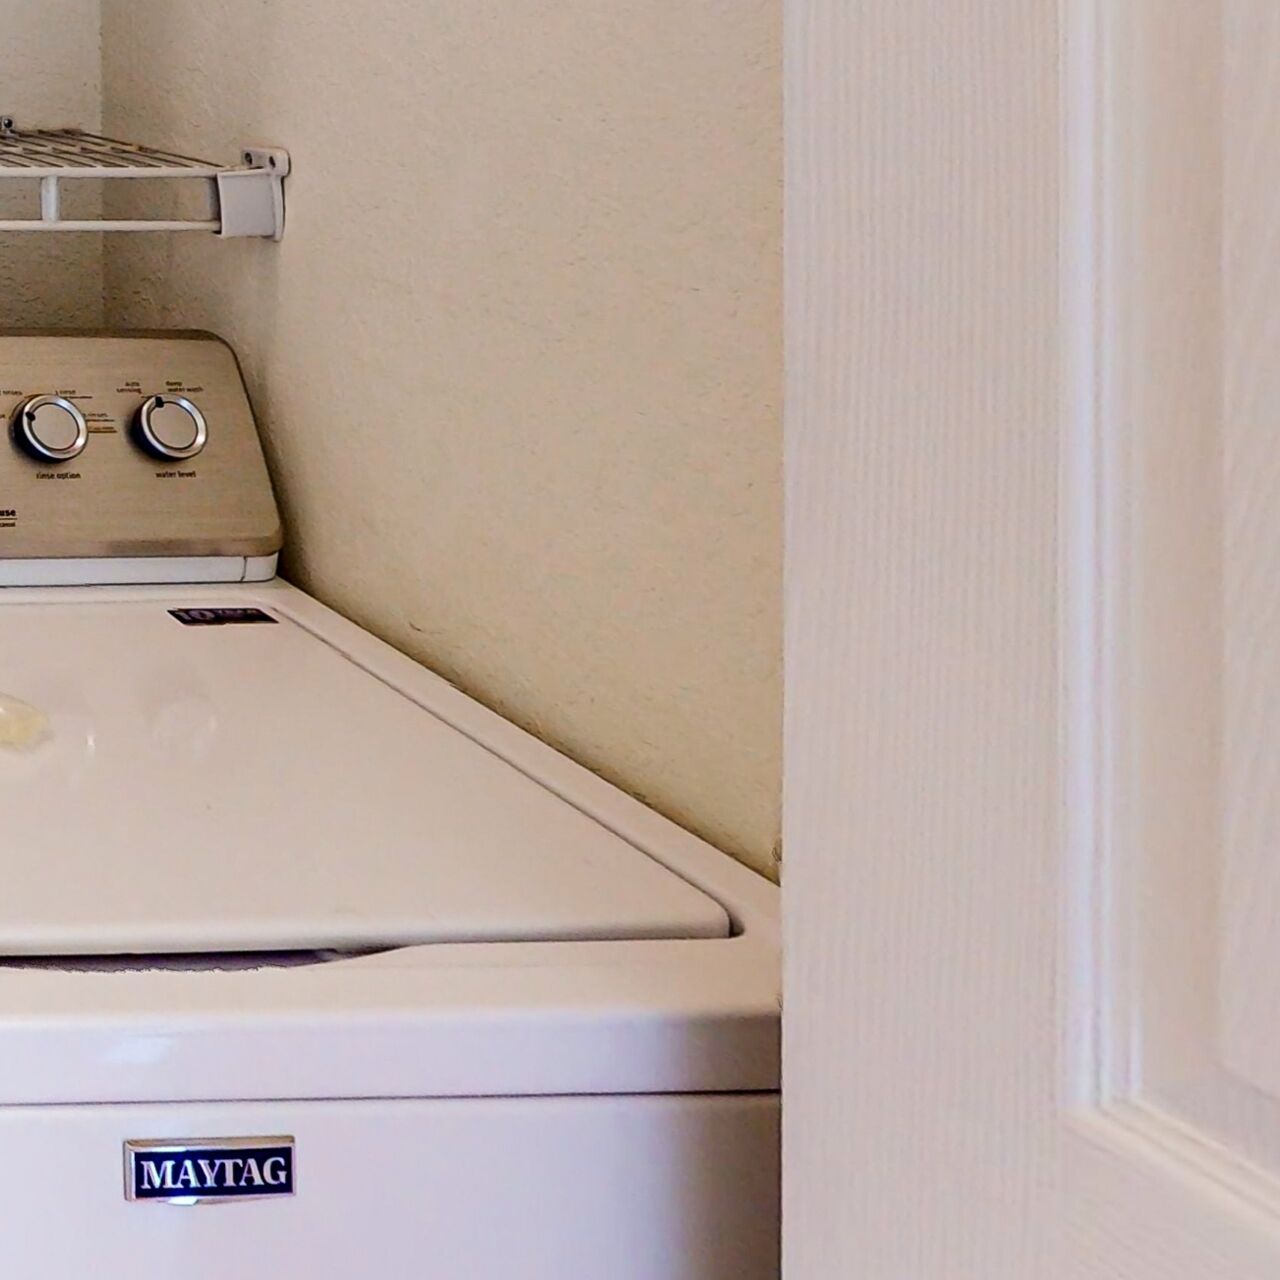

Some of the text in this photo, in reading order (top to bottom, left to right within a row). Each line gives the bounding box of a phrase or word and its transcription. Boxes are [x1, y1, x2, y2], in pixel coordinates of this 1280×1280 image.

[36, 472, 81, 481] rinse option
[140, 1157, 287, 1190] MAYTAG
